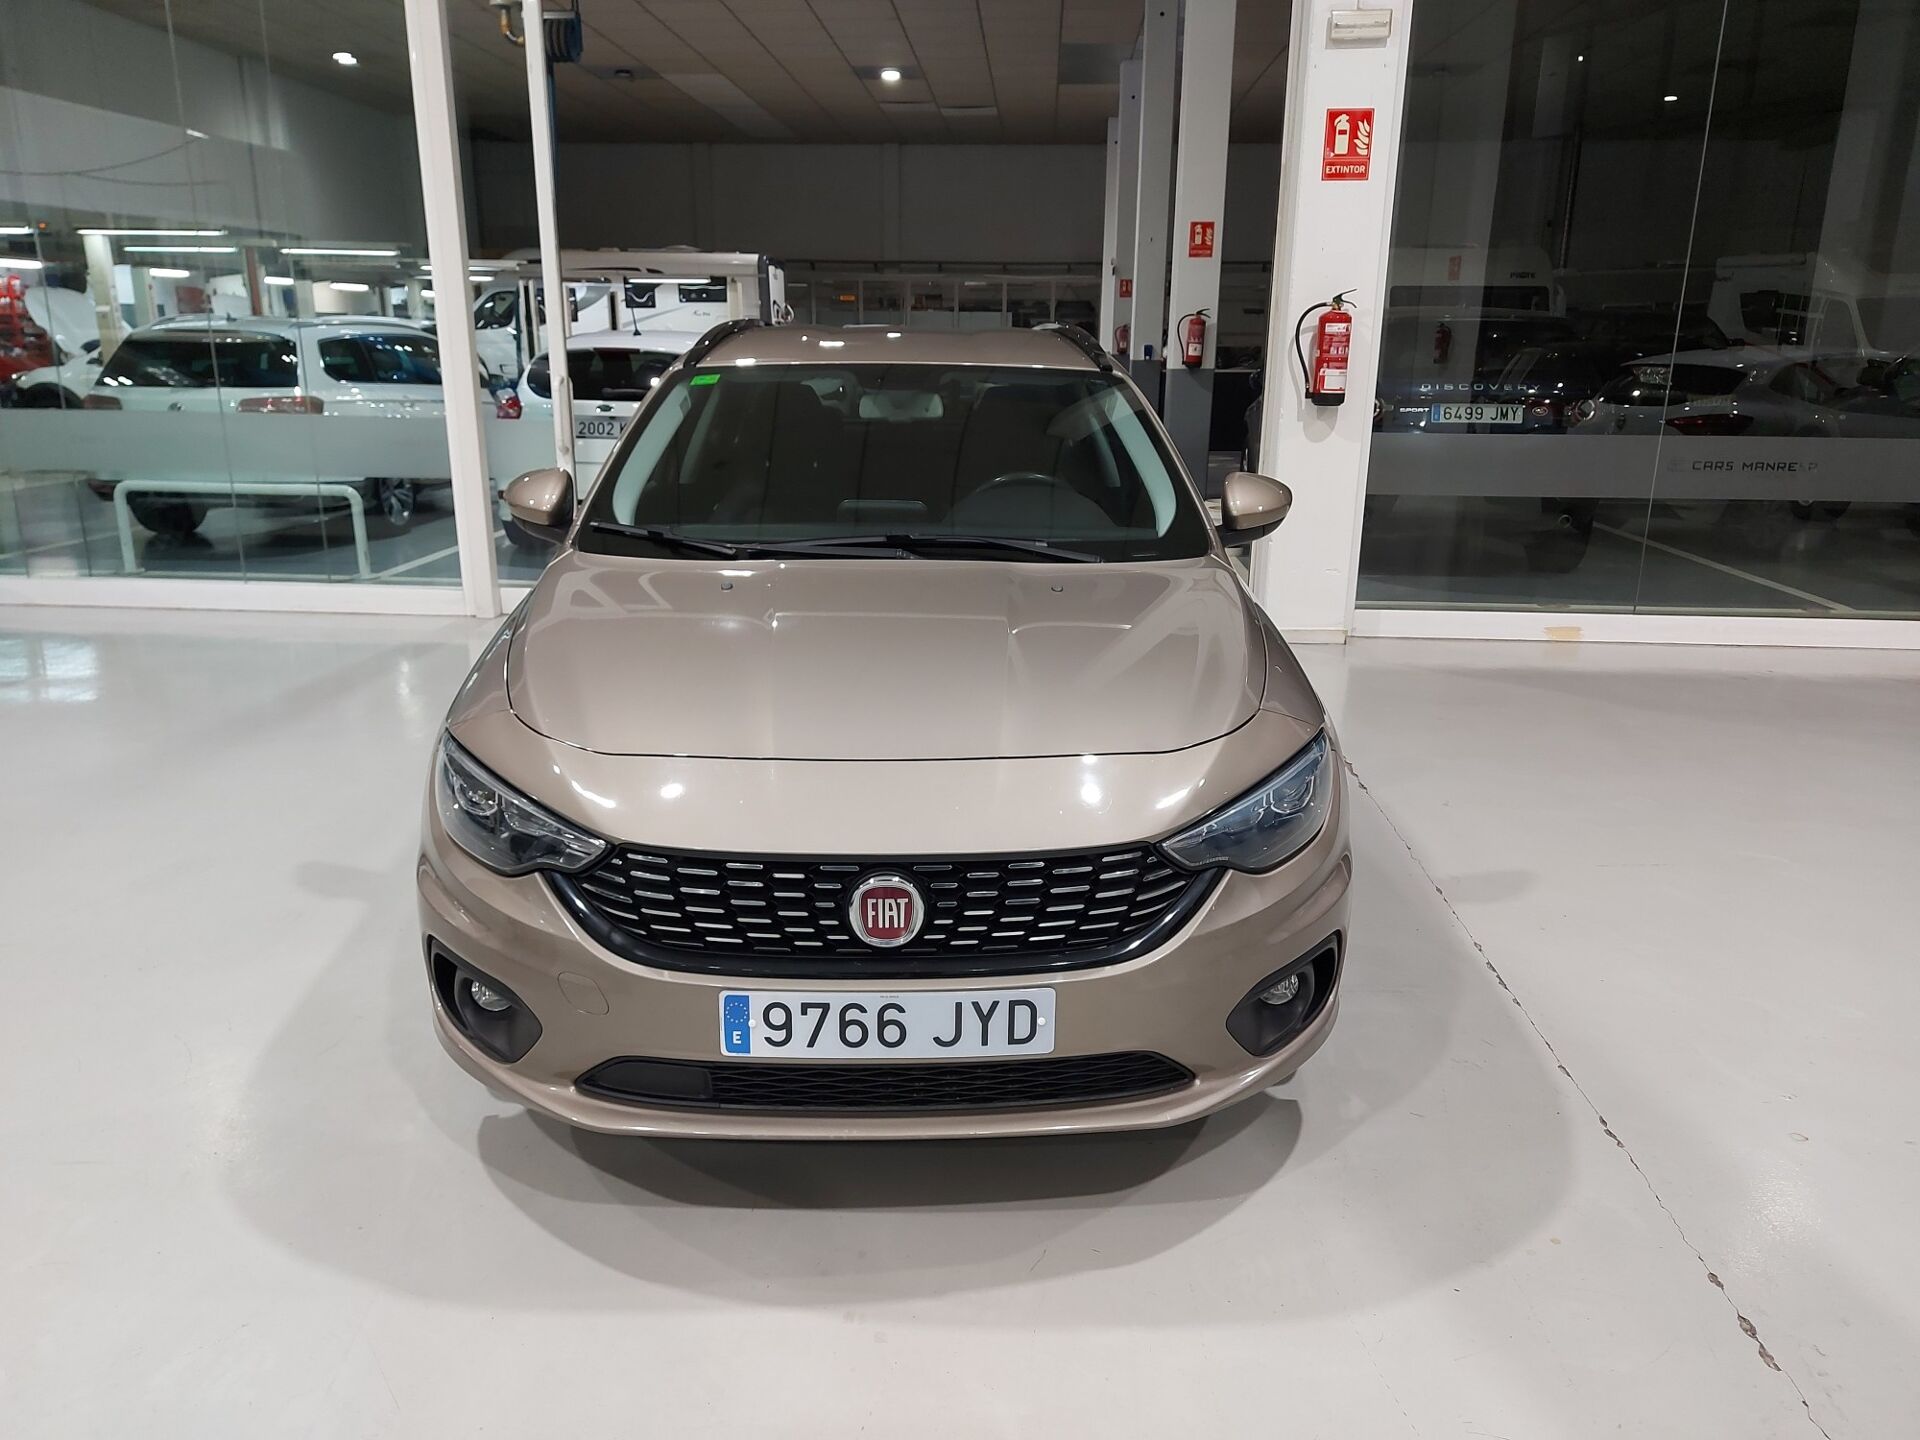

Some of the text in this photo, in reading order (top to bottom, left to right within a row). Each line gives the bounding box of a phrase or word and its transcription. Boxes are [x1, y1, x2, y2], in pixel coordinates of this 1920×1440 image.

[1325, 164, 1366, 175] EXTINTOR
[1420, 383, 1541, 391] DISCOVERY
[1443, 406, 1520, 421] 6499 JMY
[578, 421, 615, 436] 2002
[1692, 460, 1735, 471] CARS
[867, 897, 909, 929] FIAT
[732, 999, 1038, 1049] E 9766 JYD
